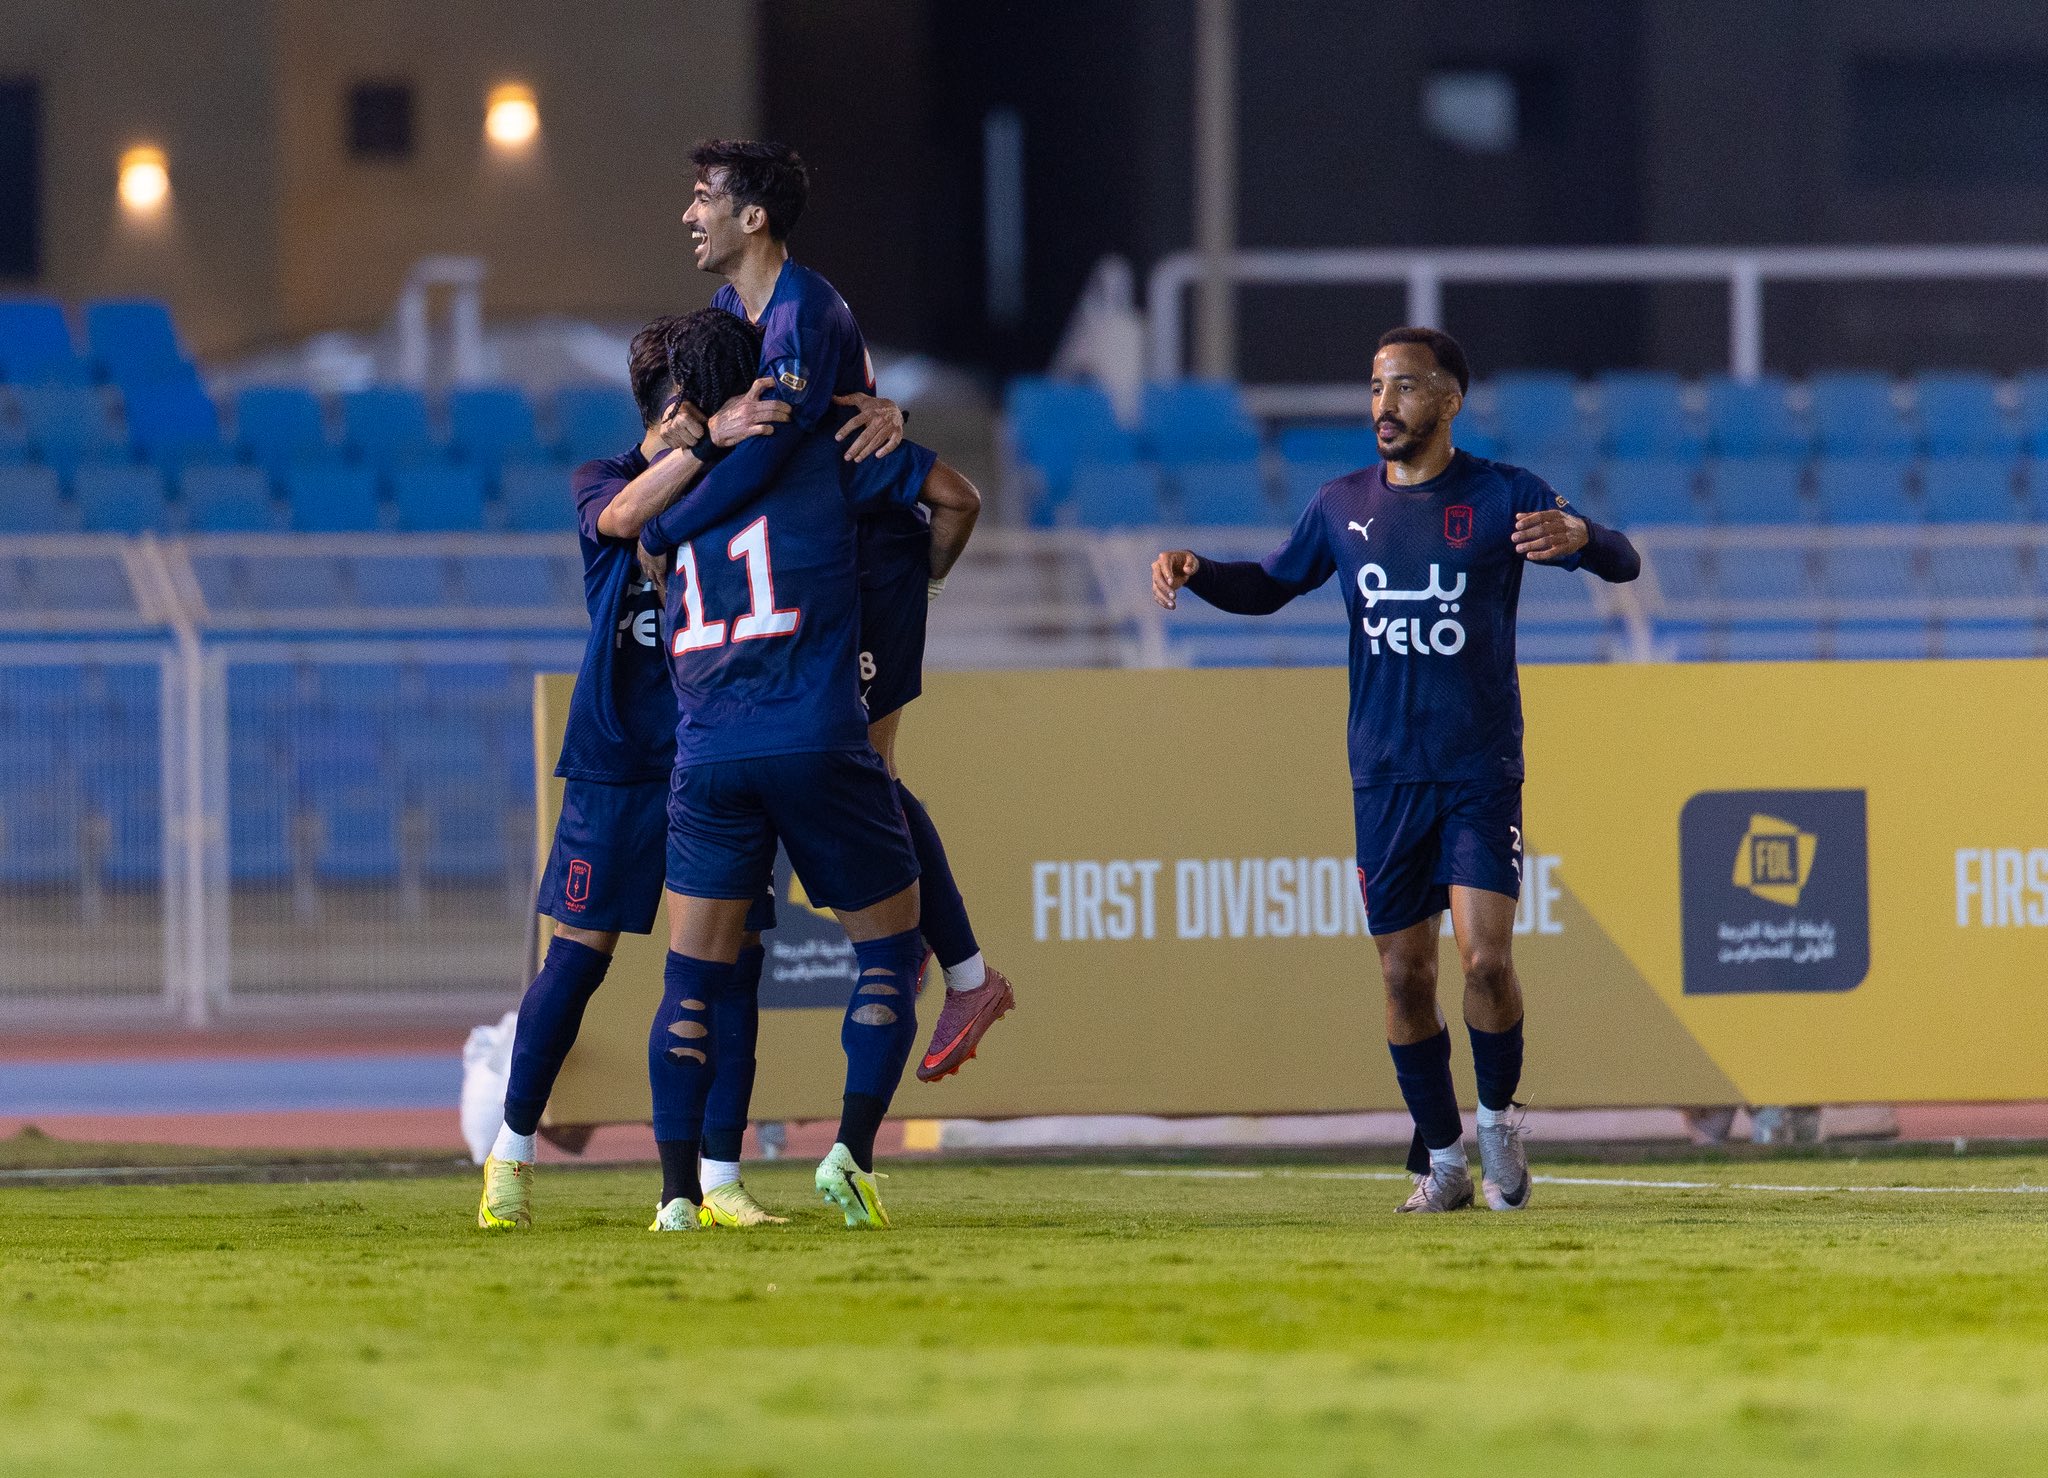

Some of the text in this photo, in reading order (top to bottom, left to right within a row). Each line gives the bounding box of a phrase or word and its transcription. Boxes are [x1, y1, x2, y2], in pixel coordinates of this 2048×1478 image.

[672, 515, 800, 657] 11
[1357, 563, 1467, 613] يلو
[1362, 617, 1466, 656] YELO
[859, 651, 877, 681] 8
[1033, 860, 1160, 941] FIRST
